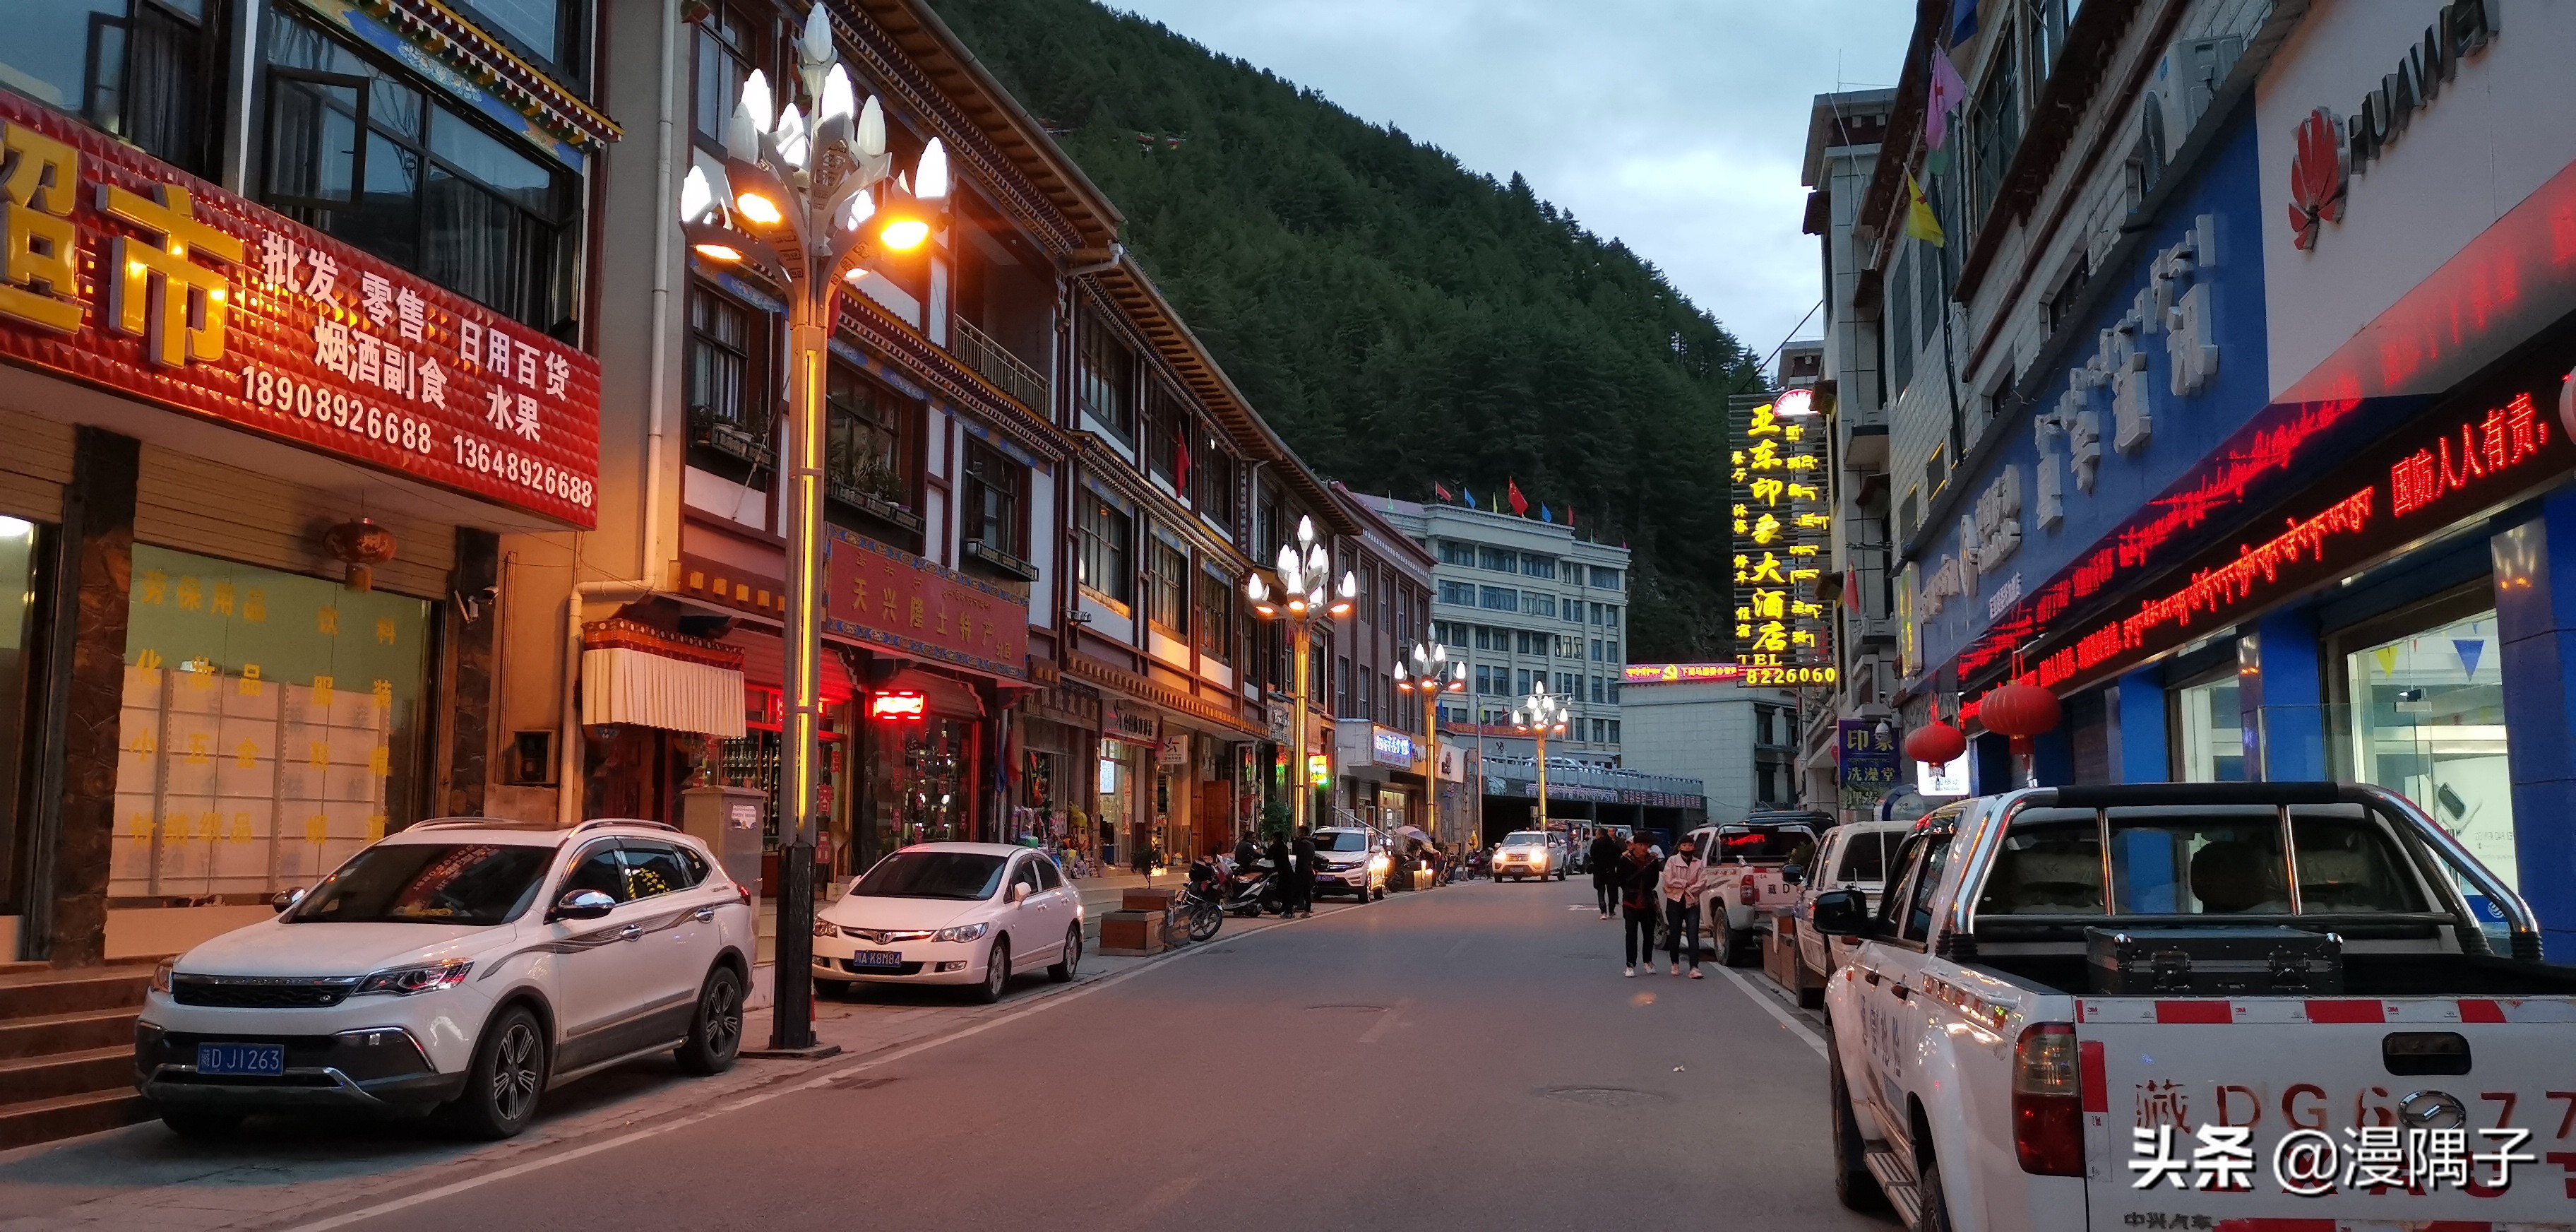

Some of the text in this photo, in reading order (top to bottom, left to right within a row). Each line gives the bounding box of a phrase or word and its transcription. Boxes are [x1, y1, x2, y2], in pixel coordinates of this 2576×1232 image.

[261, 232, 571, 401] 批发 零售 日用百货
[314, 319, 541, 443] 烟酒副食 水果
[242, 365, 593, 508] 18908926688 13648926688
[1748, 403, 1787, 651] 亚东印象大酒店
[142, 569, 267, 623] 劳保用品
[852, 577, 994, 646] 天兴隆土特产
[136, 648, 393, 707] 化妆品 服装
[1737, 653, 1782, 665] TEL
[1746, 668, 1836, 685] 8226060
[130, 728, 260, 769] 小五金
[1847, 766, 1895, 781] 洗澡堂
